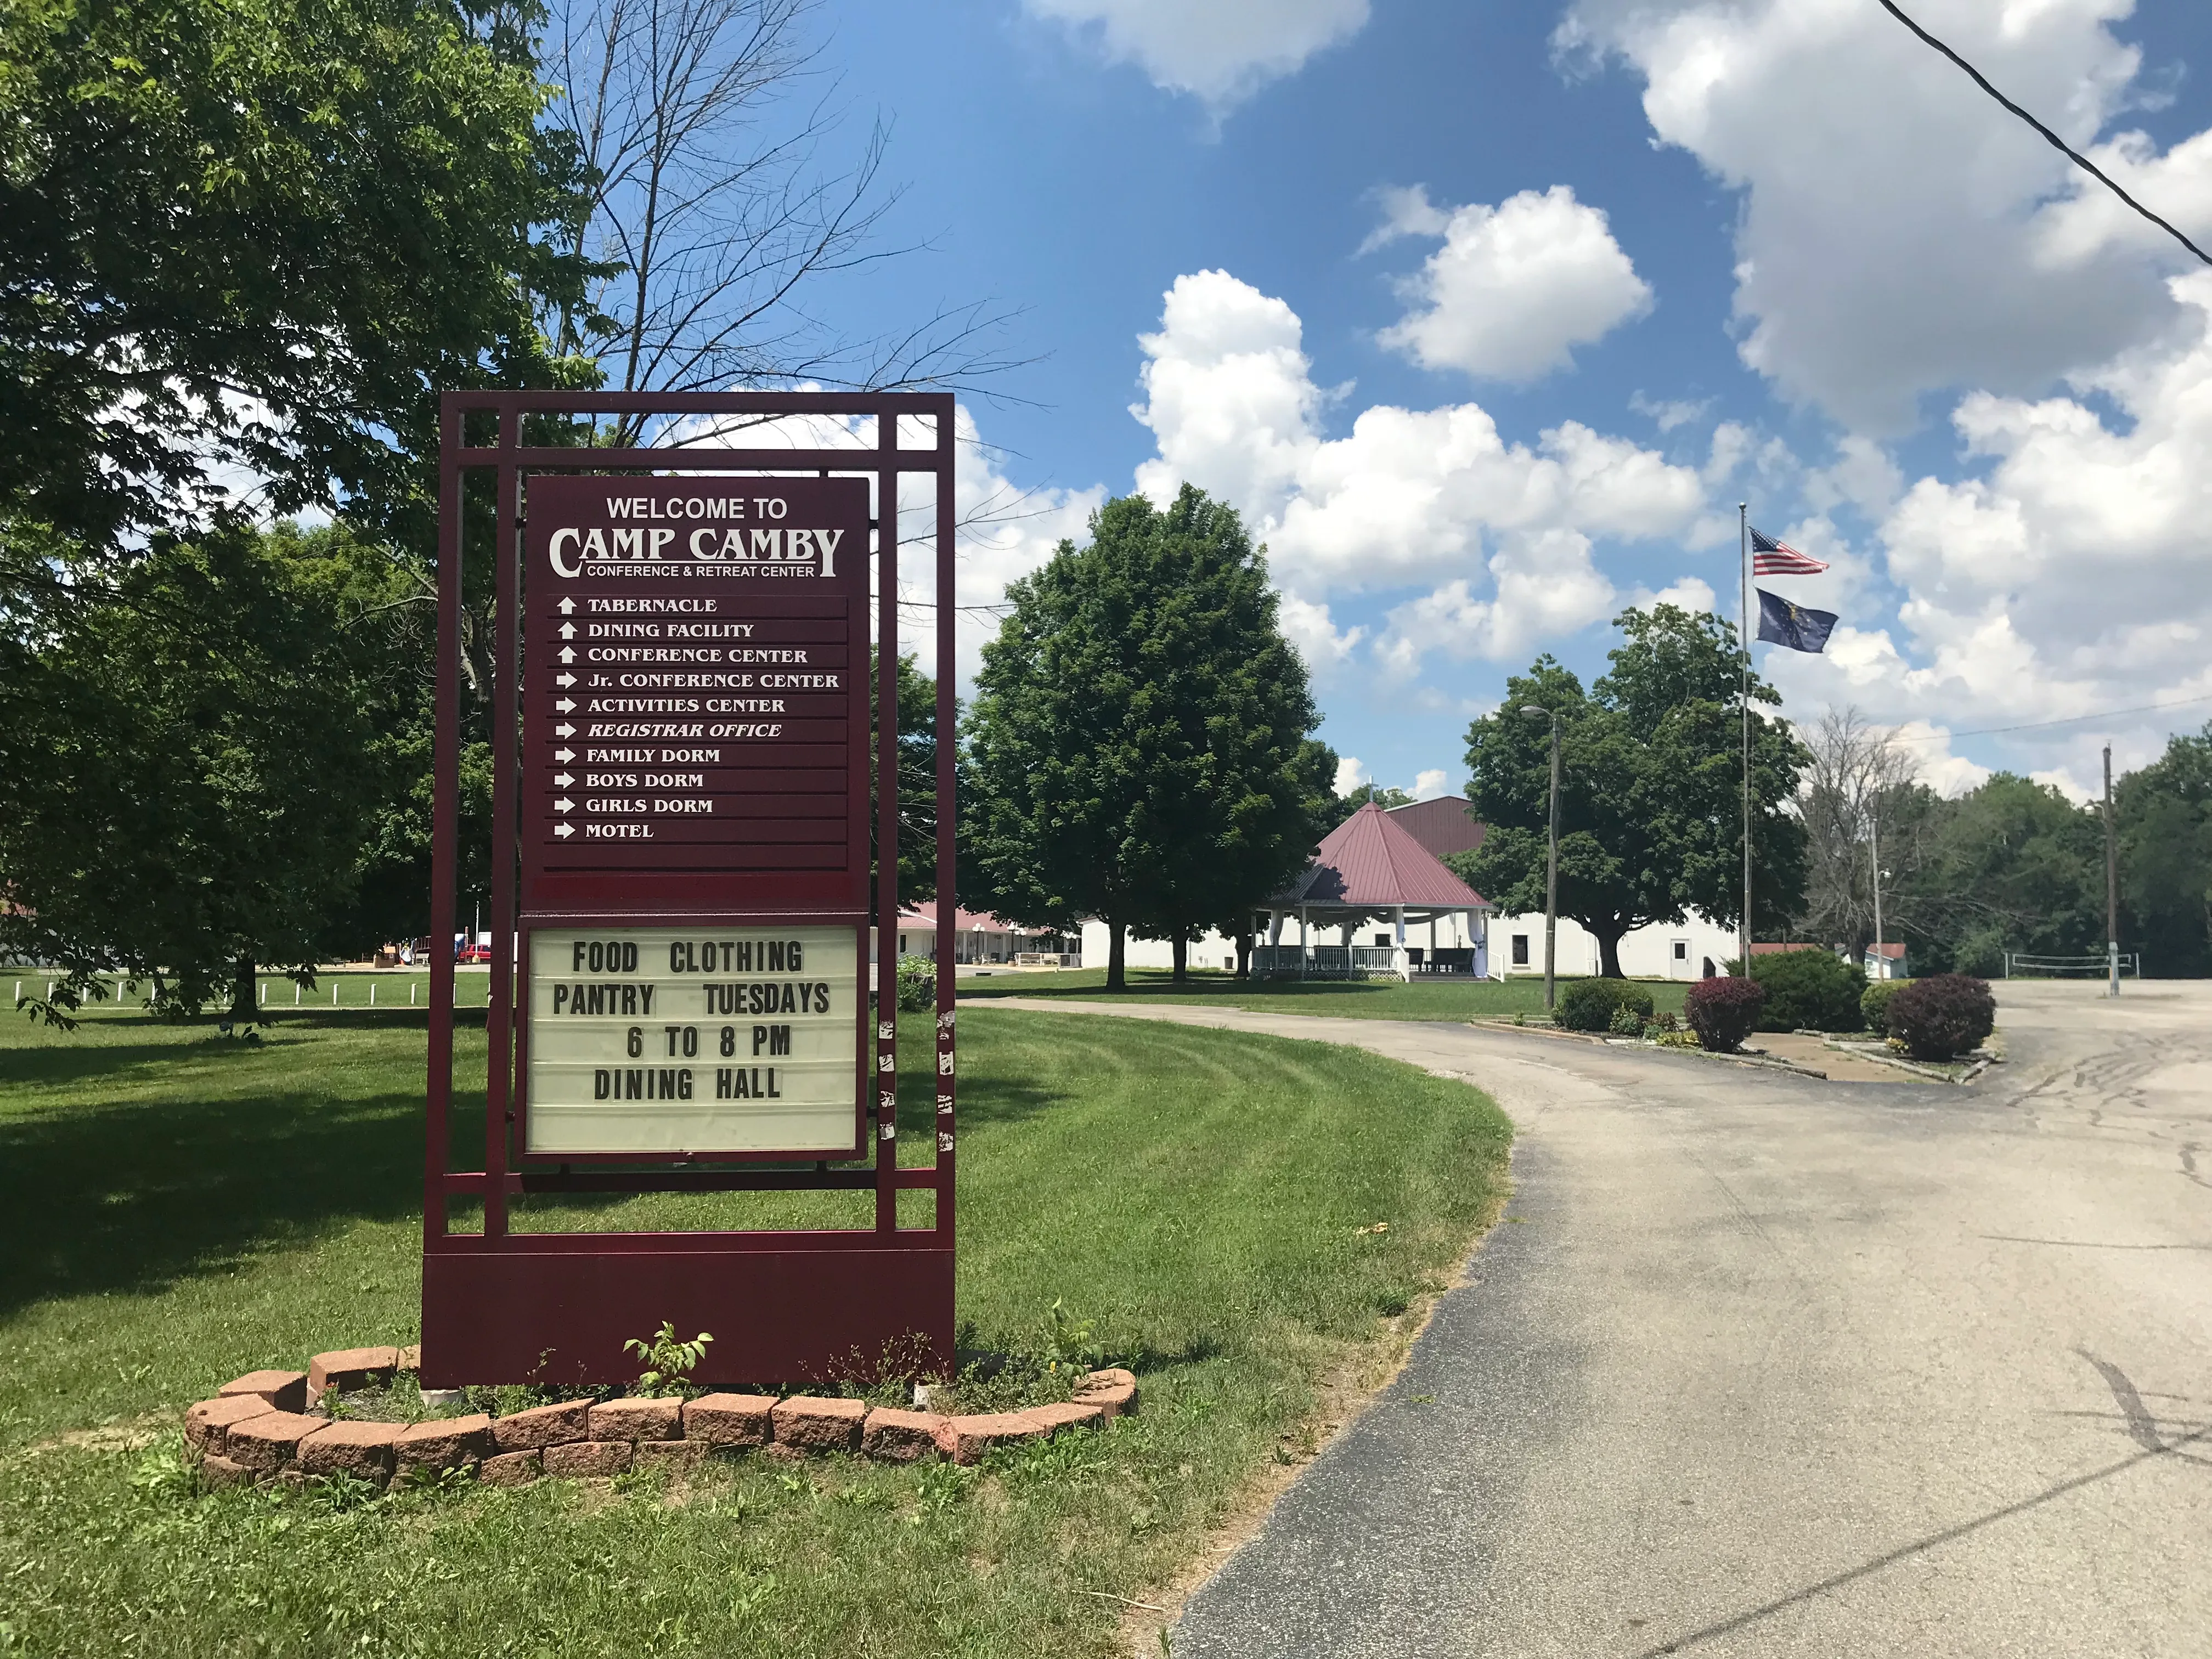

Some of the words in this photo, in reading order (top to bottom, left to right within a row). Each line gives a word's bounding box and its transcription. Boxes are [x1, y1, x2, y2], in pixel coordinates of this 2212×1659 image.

[607, 498, 744, 518] WELCOME
[753, 499, 787, 518] TO
[549, 528, 675, 578] CAMP
[689, 528, 845, 577] CAMBY
[588, 566, 679, 576] CONFERENCE
[684, 566, 692, 576] &
[697, 566, 757, 577] RETREAT
[760, 566, 815, 577] CENTER
[588, 600, 717, 612] TABERNACLE
[589, 624, 659, 636] DINING
[668, 625, 754, 636] FACILITY
[589, 648, 722, 661] CONFERENCE
[729, 650, 808, 663] CENTER
[588, 674, 612, 686] Jr.
[620, 674, 753, 687] CONFERENCE
[760, 675, 839, 687] CENTER
[588, 699, 699, 712] ACTIVITIES
[706, 699, 785, 712] CENTER
[588, 724, 703, 736] REGISTRAR
[710, 725, 781, 736] OFFICE
[587, 749, 656, 761] FAMILY
[662, 750, 720, 761] DORM
[586, 775, 637, 787] BOYS
[645, 775, 703, 787] DORM
[586, 799, 647, 811] GIRLS
[654, 800, 713, 812] DORM
[586, 825, 654, 837] MOTEL
[573, 941, 638, 972] FOOD
[670, 941, 801, 973] CLOTHING
[554, 984, 654, 1014] PANTRY
[703, 983, 828, 1014] TUESDAYS
[628, 1027, 642, 1058] 6
[665, 1026, 697, 1057] TO
[720, 1026, 734, 1057] 8
[753, 1025, 789, 1056] PM
[595, 1069, 692, 1099] DINING
[717, 1068, 780, 1098] HALL
